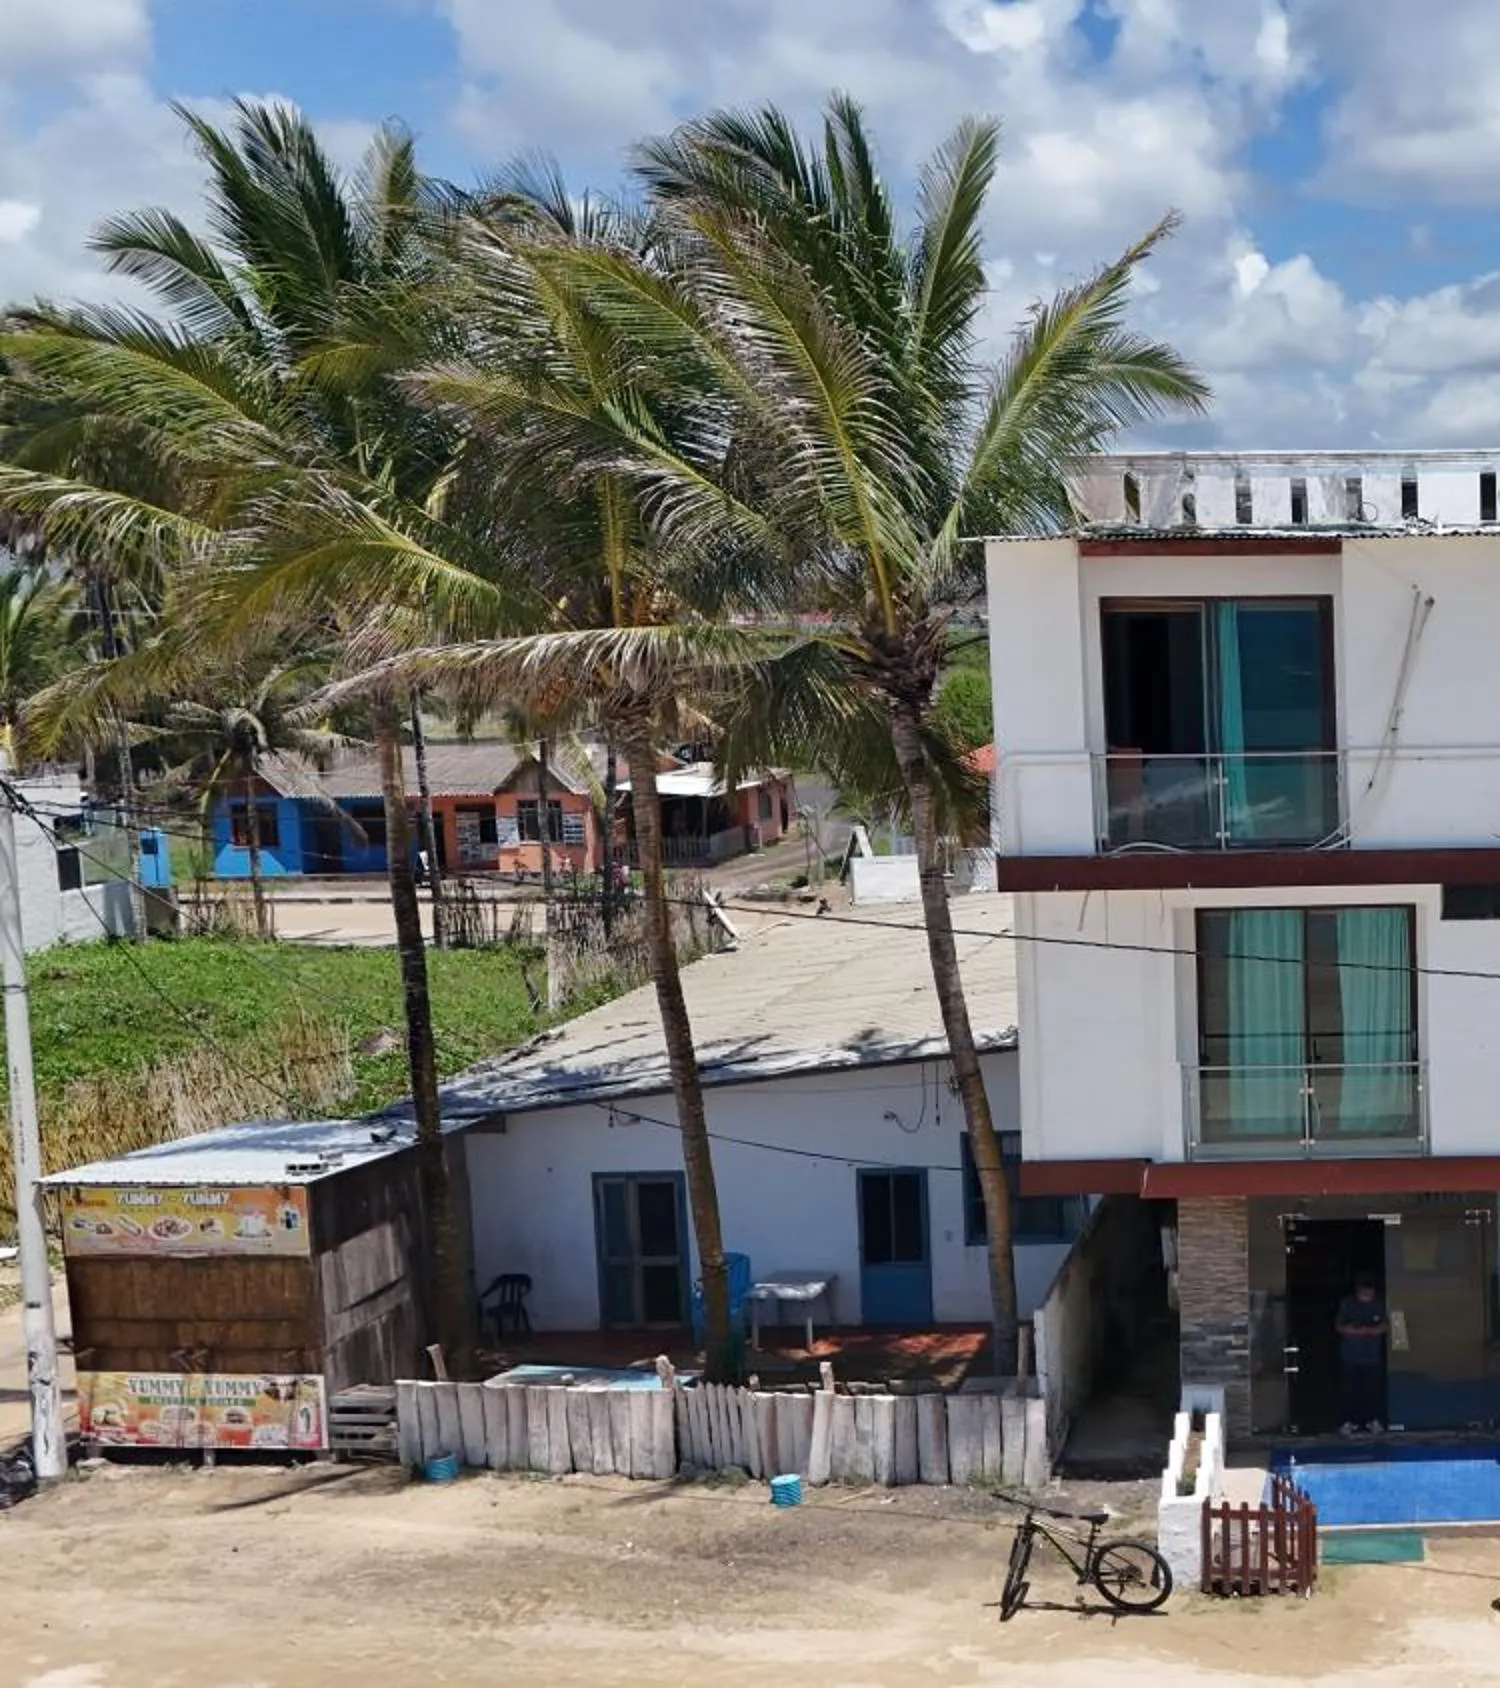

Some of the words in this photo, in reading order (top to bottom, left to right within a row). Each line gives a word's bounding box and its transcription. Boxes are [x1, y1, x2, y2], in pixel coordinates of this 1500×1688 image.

[182, 1191, 231, 1205] YUMMY
[128, 1378, 186, 1396] YUMMY
[203, 1379, 262, 1397] YUMMY
